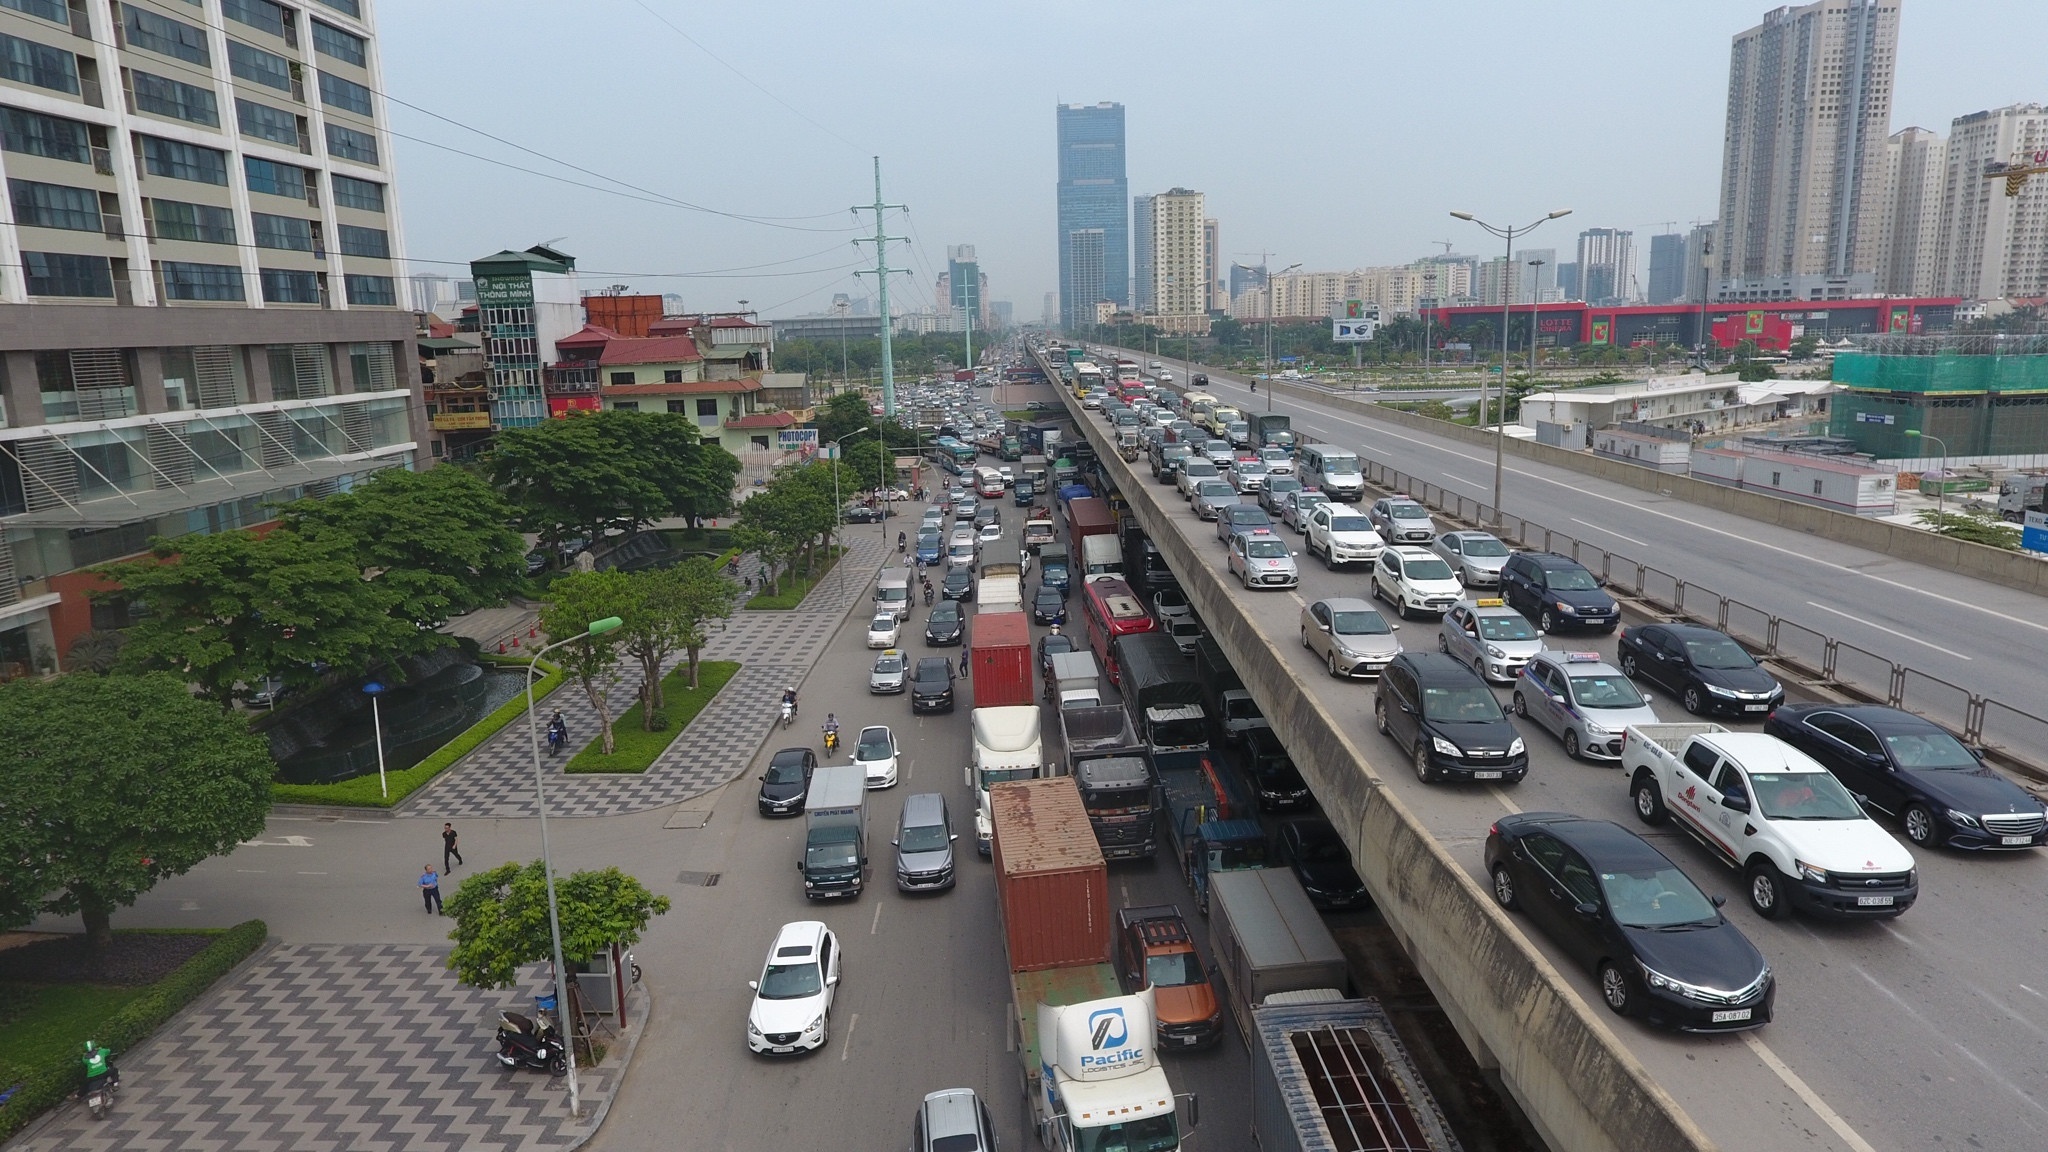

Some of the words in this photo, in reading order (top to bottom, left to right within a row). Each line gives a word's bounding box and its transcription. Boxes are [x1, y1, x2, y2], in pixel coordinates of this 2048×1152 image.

[1540, 318, 1573, 326] LOTTE
[778, 431, 817, 442] PHOTOCOPY
[2028, 515, 2043, 523] TEXO
[1081, 1048, 1143, 1067] Pacific
[1081, 1063, 1126, 1073] LOGISTICS
